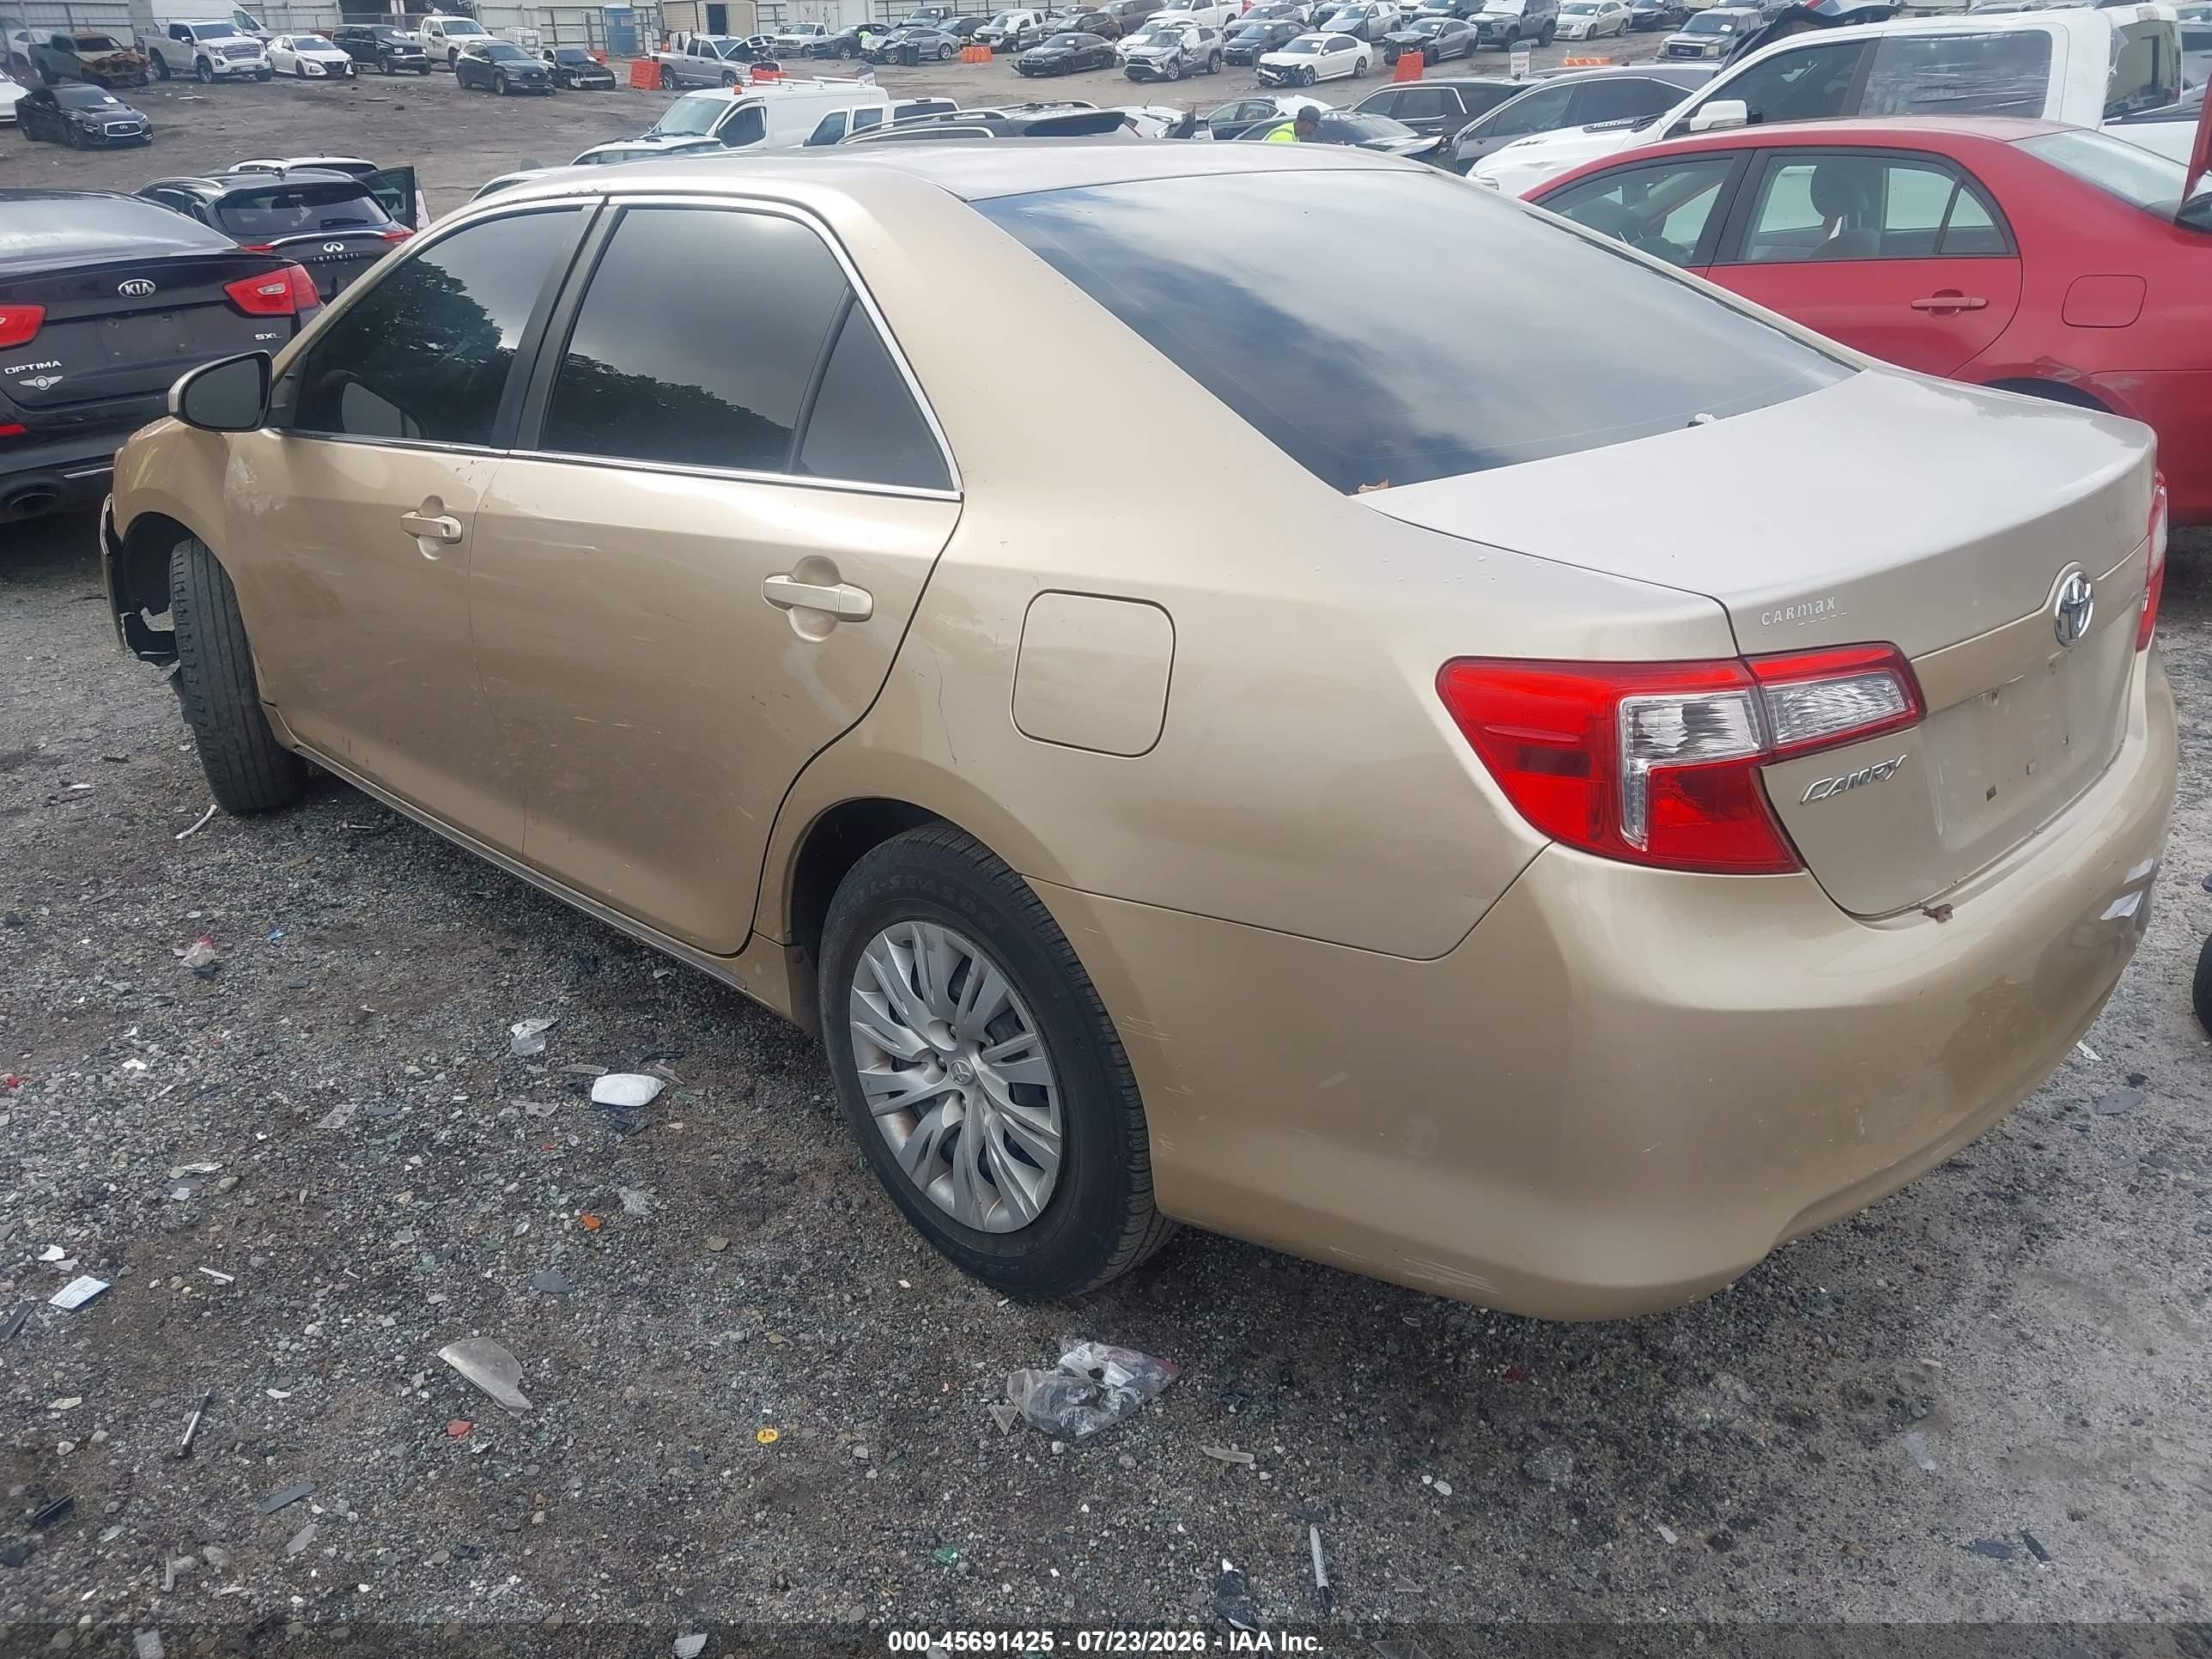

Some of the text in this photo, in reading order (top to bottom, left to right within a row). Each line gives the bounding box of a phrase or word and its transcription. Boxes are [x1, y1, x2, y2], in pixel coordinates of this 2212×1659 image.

[313, 252, 360, 262] INFINITI
[124, 282, 154, 295] KIA
[255, 332, 283, 341] SXL
[4, 359, 63, 374] OPTIMA
[1801, 755, 1908, 805] CAMRY
